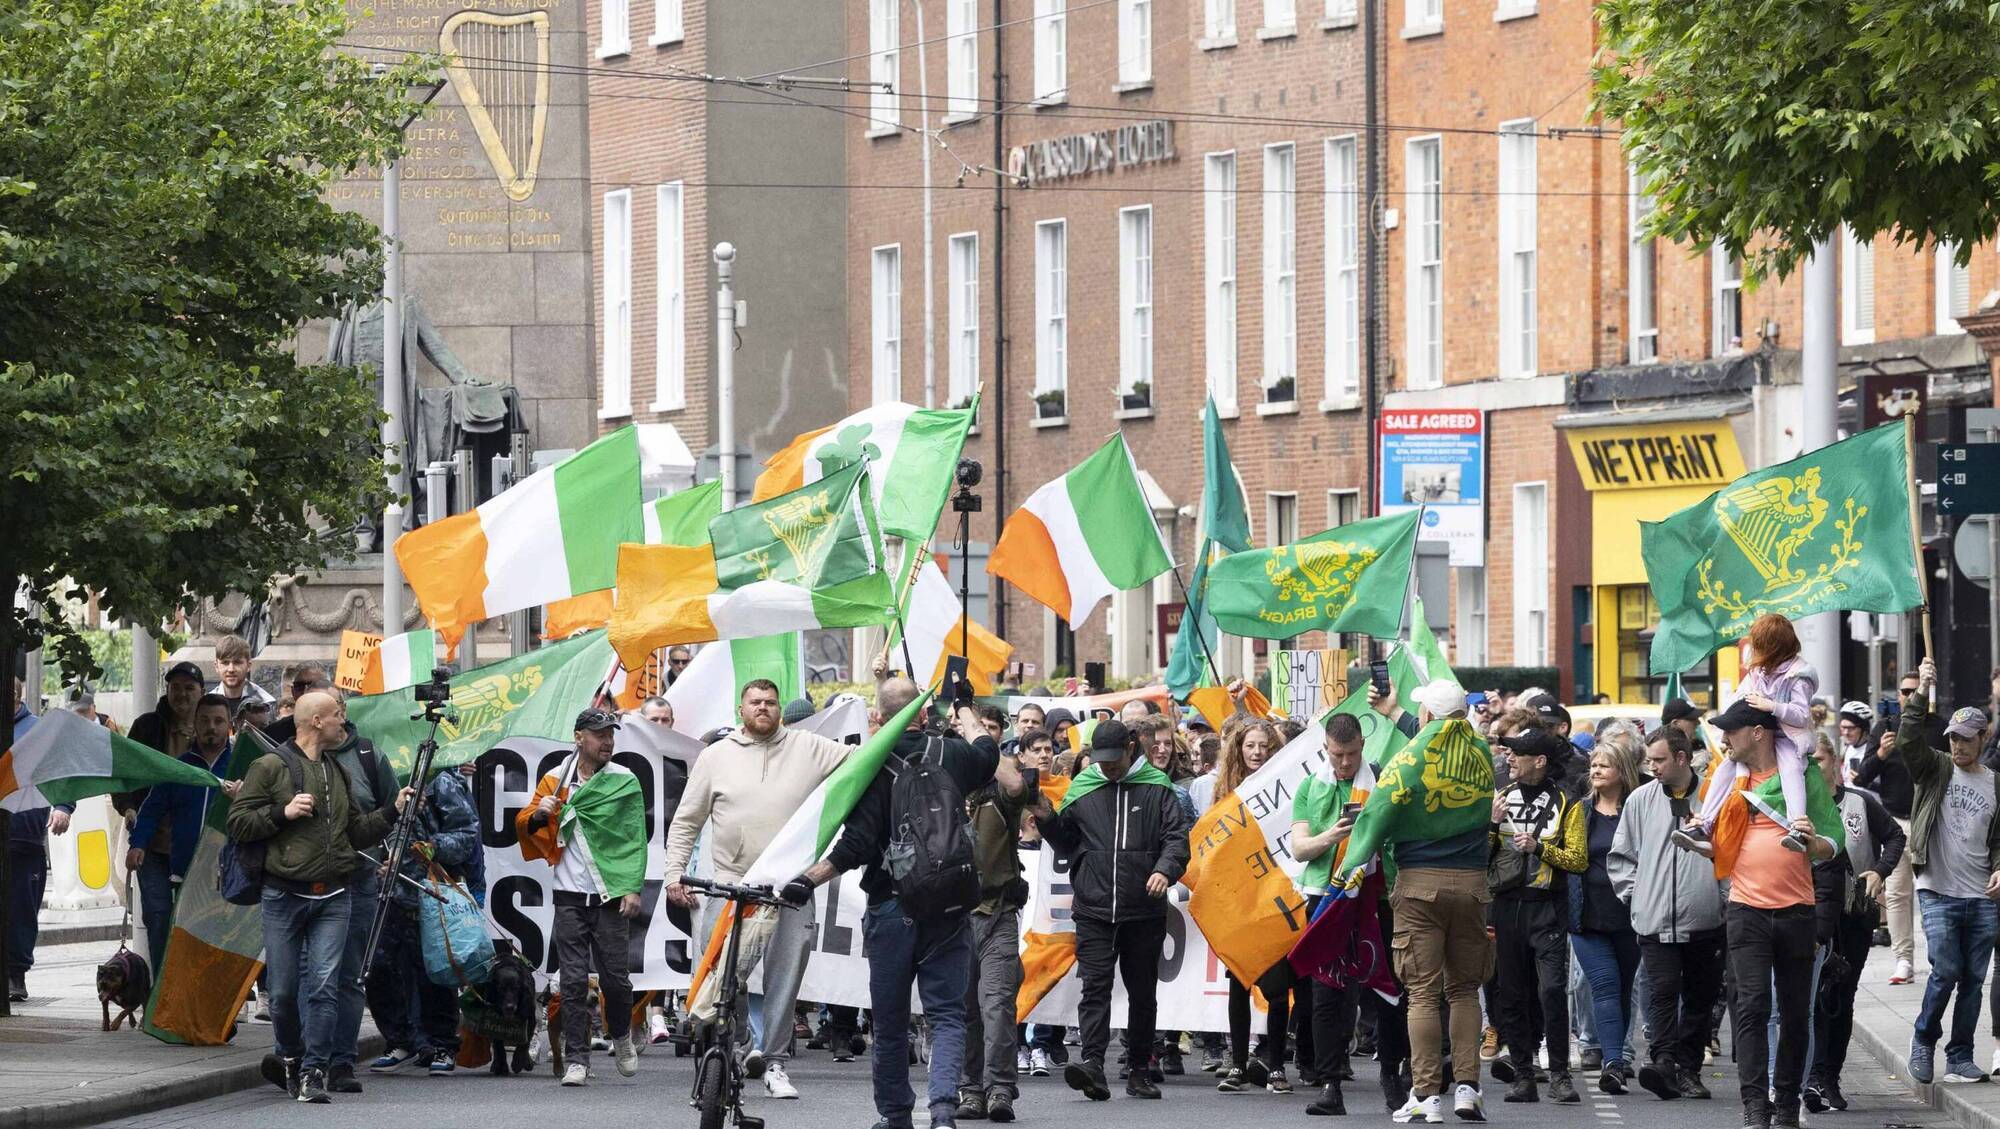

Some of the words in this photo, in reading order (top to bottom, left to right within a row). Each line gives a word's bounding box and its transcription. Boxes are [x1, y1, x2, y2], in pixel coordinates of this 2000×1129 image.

[504, 0, 559, 9] NATION
[396, 16, 440, 29] RIGHT
[407, 128, 460, 141] ULTRA
[1117, 119, 1175, 167] HOTEL
[450, 148, 469, 160] OF
[1385, 414, 1418, 430] SALE
[1420, 414, 1476, 429] AGREED
